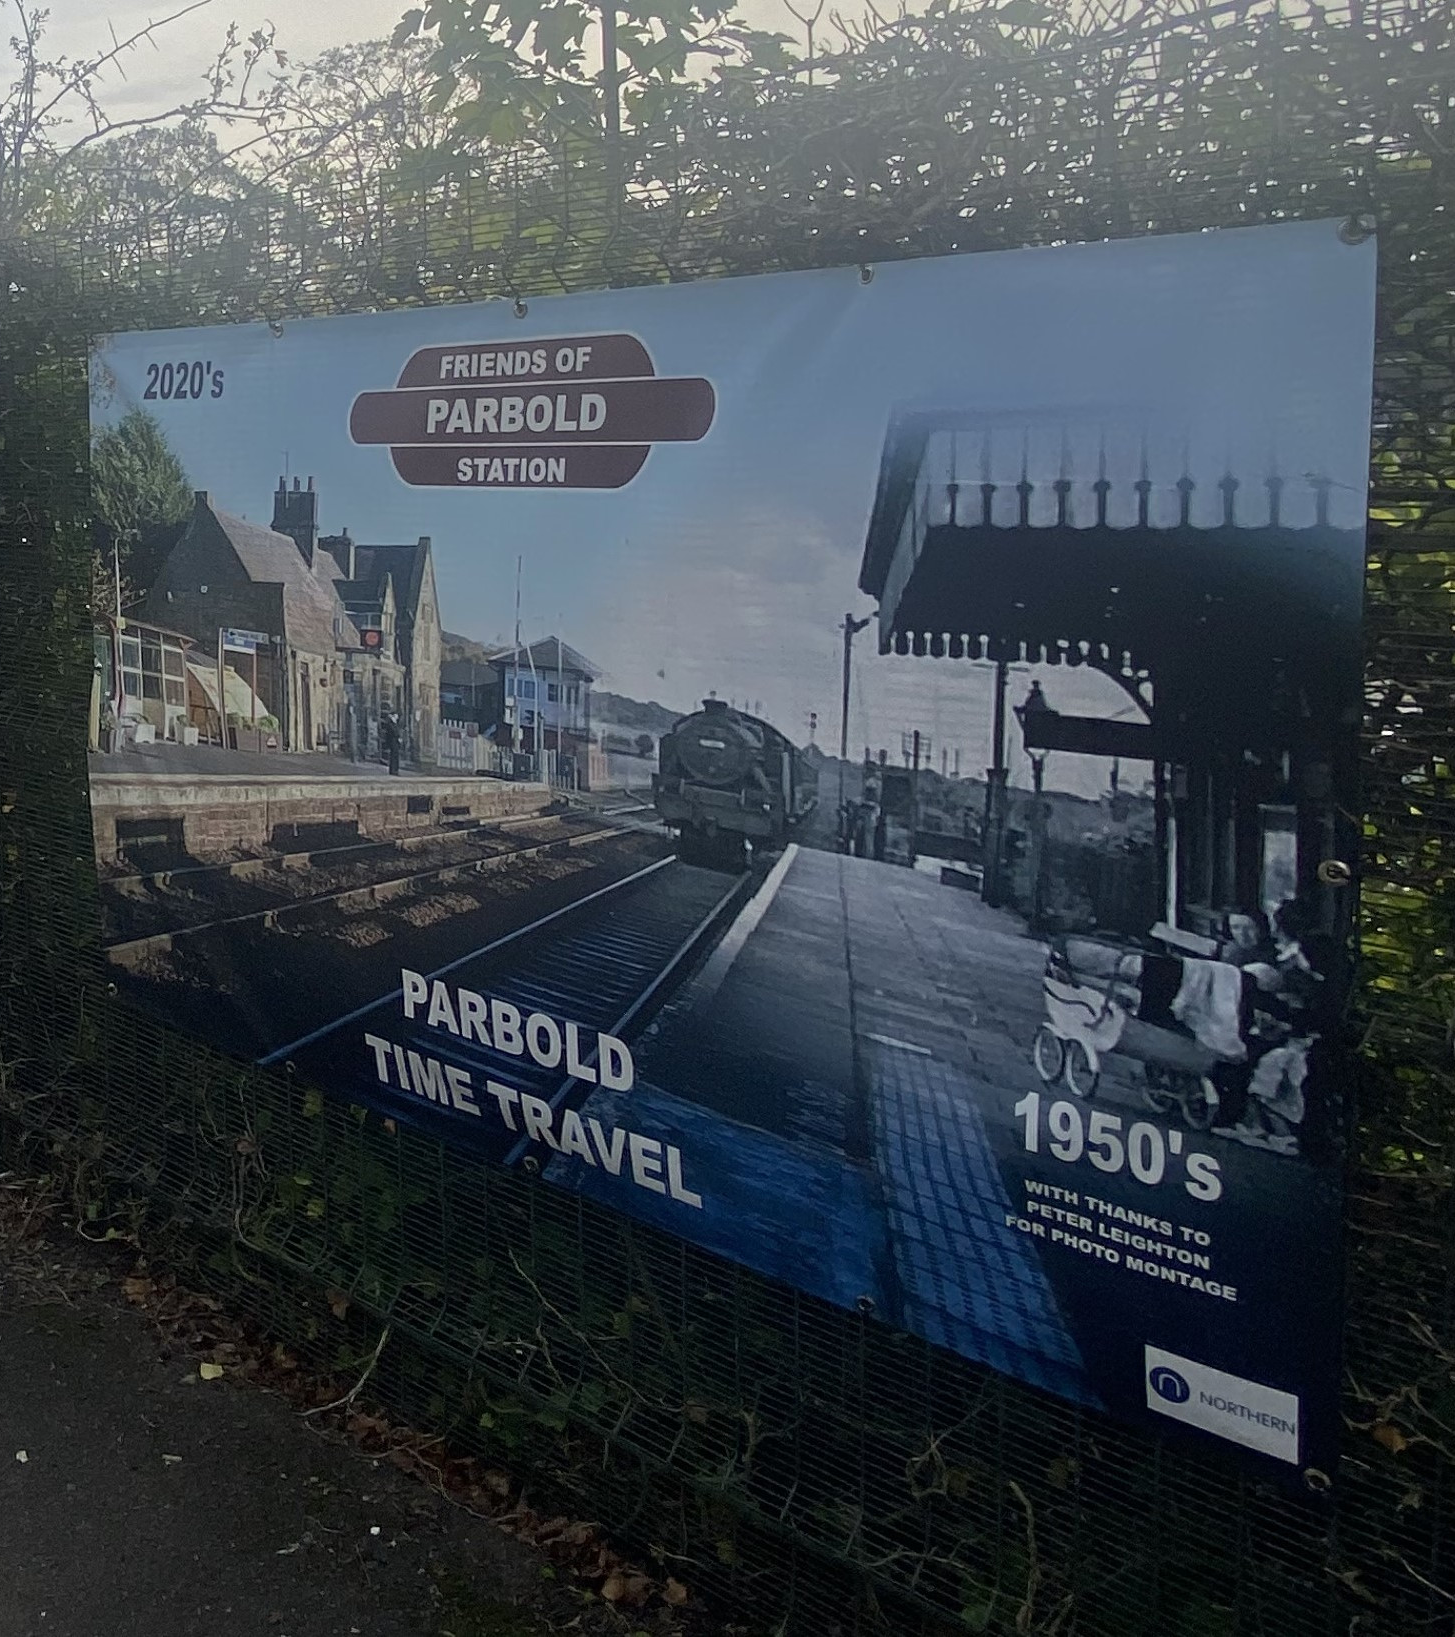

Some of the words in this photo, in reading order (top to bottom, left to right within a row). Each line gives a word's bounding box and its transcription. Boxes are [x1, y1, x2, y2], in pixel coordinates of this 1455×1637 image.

[143, 360, 225, 400] 2020's
[440, 350, 547, 379] FRIENDS
[555, 346, 592, 373] OF
[426, 393, 607, 434] PARBOLD
[457, 457, 566, 483] STATION
[401, 968, 634, 1092] PARBOLD
[364, 1033, 482, 1116] TIME
[486, 1080, 703, 1209] TRAVEL
[1014, 1091, 1222, 1201] 1950's
[1025, 1179, 1078, 1205] WITH
[1084, 1196, 1173, 1236] THANKS
[1179, 1226, 1211, 1246] TO
[1026, 1200, 1093, 1232] PETER
[1098, 1222, 1210, 1270] LEIGHTON
[1005, 1214, 1045, 1237] FOR
[1050, 1228, 1120, 1263] PHOTO
[1126, 1255, 1238, 1302] MONTAGE
[1200, 1391, 1295, 1435] NORTHERN
